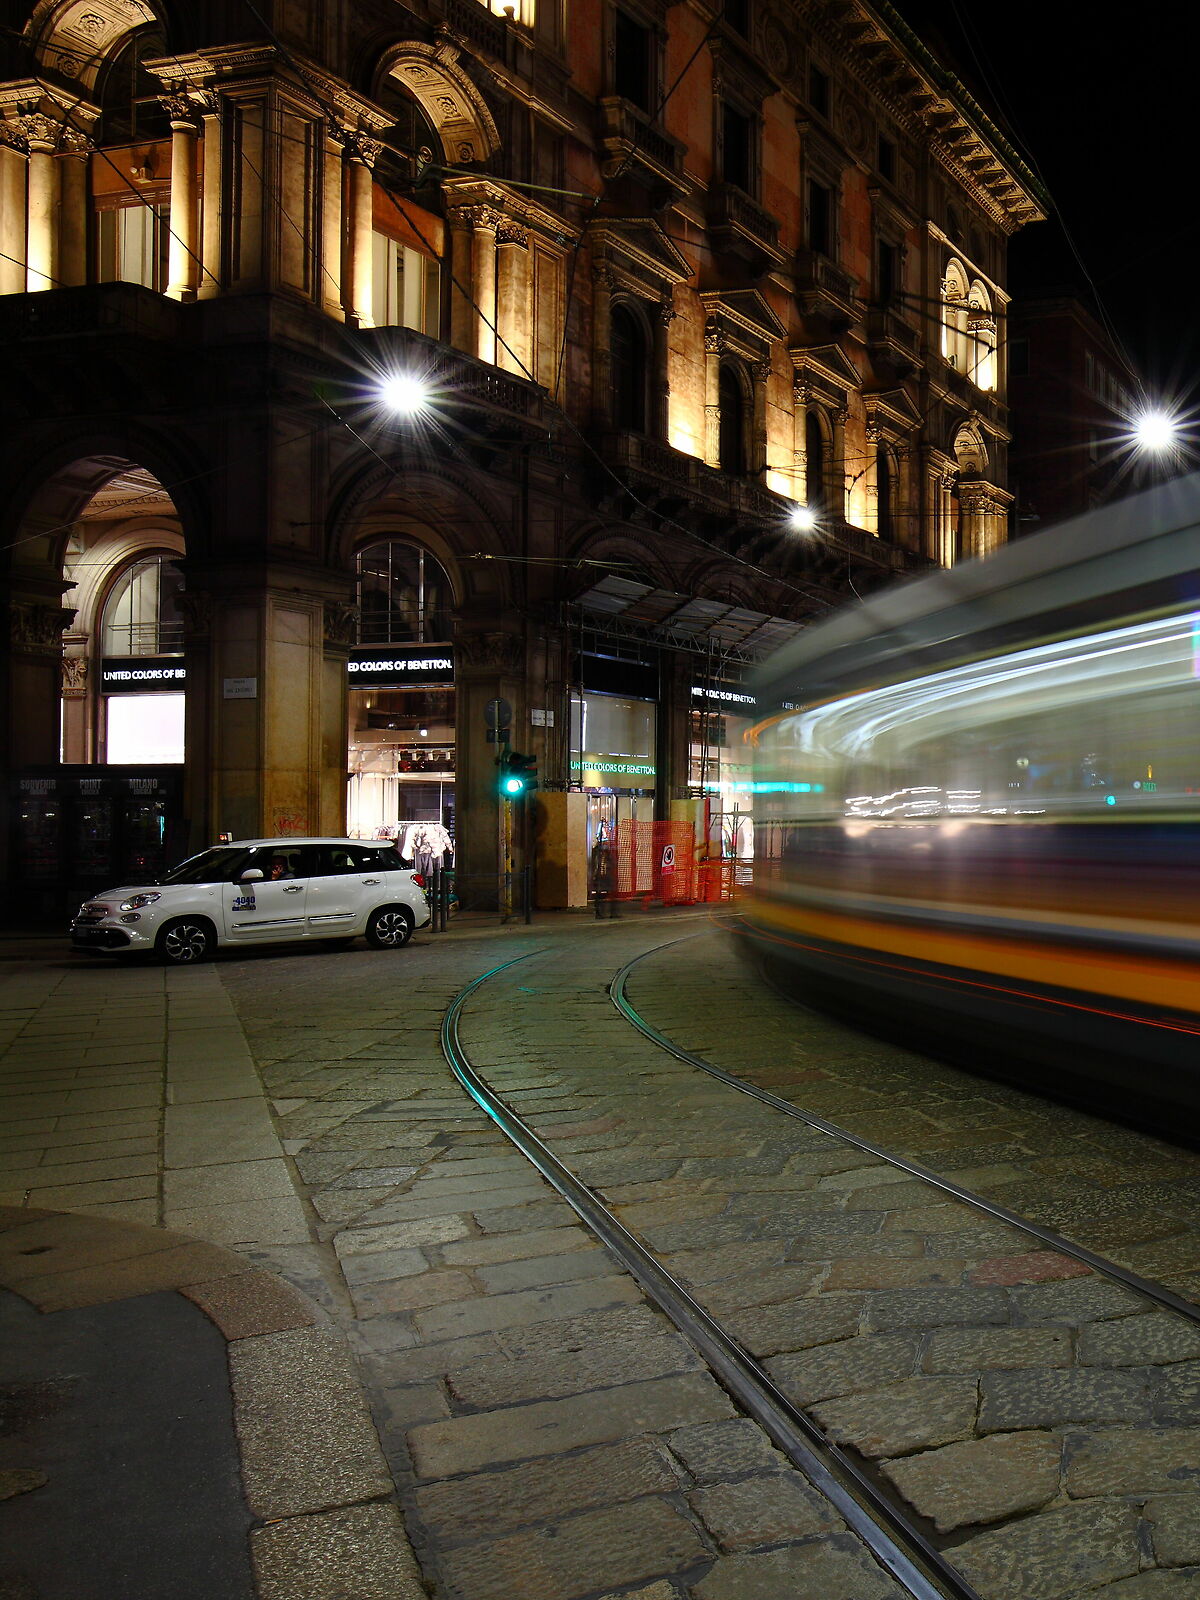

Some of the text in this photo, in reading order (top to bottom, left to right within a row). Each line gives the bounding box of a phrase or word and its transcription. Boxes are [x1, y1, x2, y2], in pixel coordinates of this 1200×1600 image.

[360, 661, 393, 671] COLORS
[394, 660, 406, 670] OF
[103, 671, 131, 681] UNITED
[132, 670, 162, 679] COLORS
[163, 669, 174, 679] OF
[593, 763, 618, 773] COLORS
[618, 764, 627, 773] OF
[79, 778, 103, 790] POINT
[128, 778, 158, 790] MILANO
[235, 896, 256, 905] 4040
